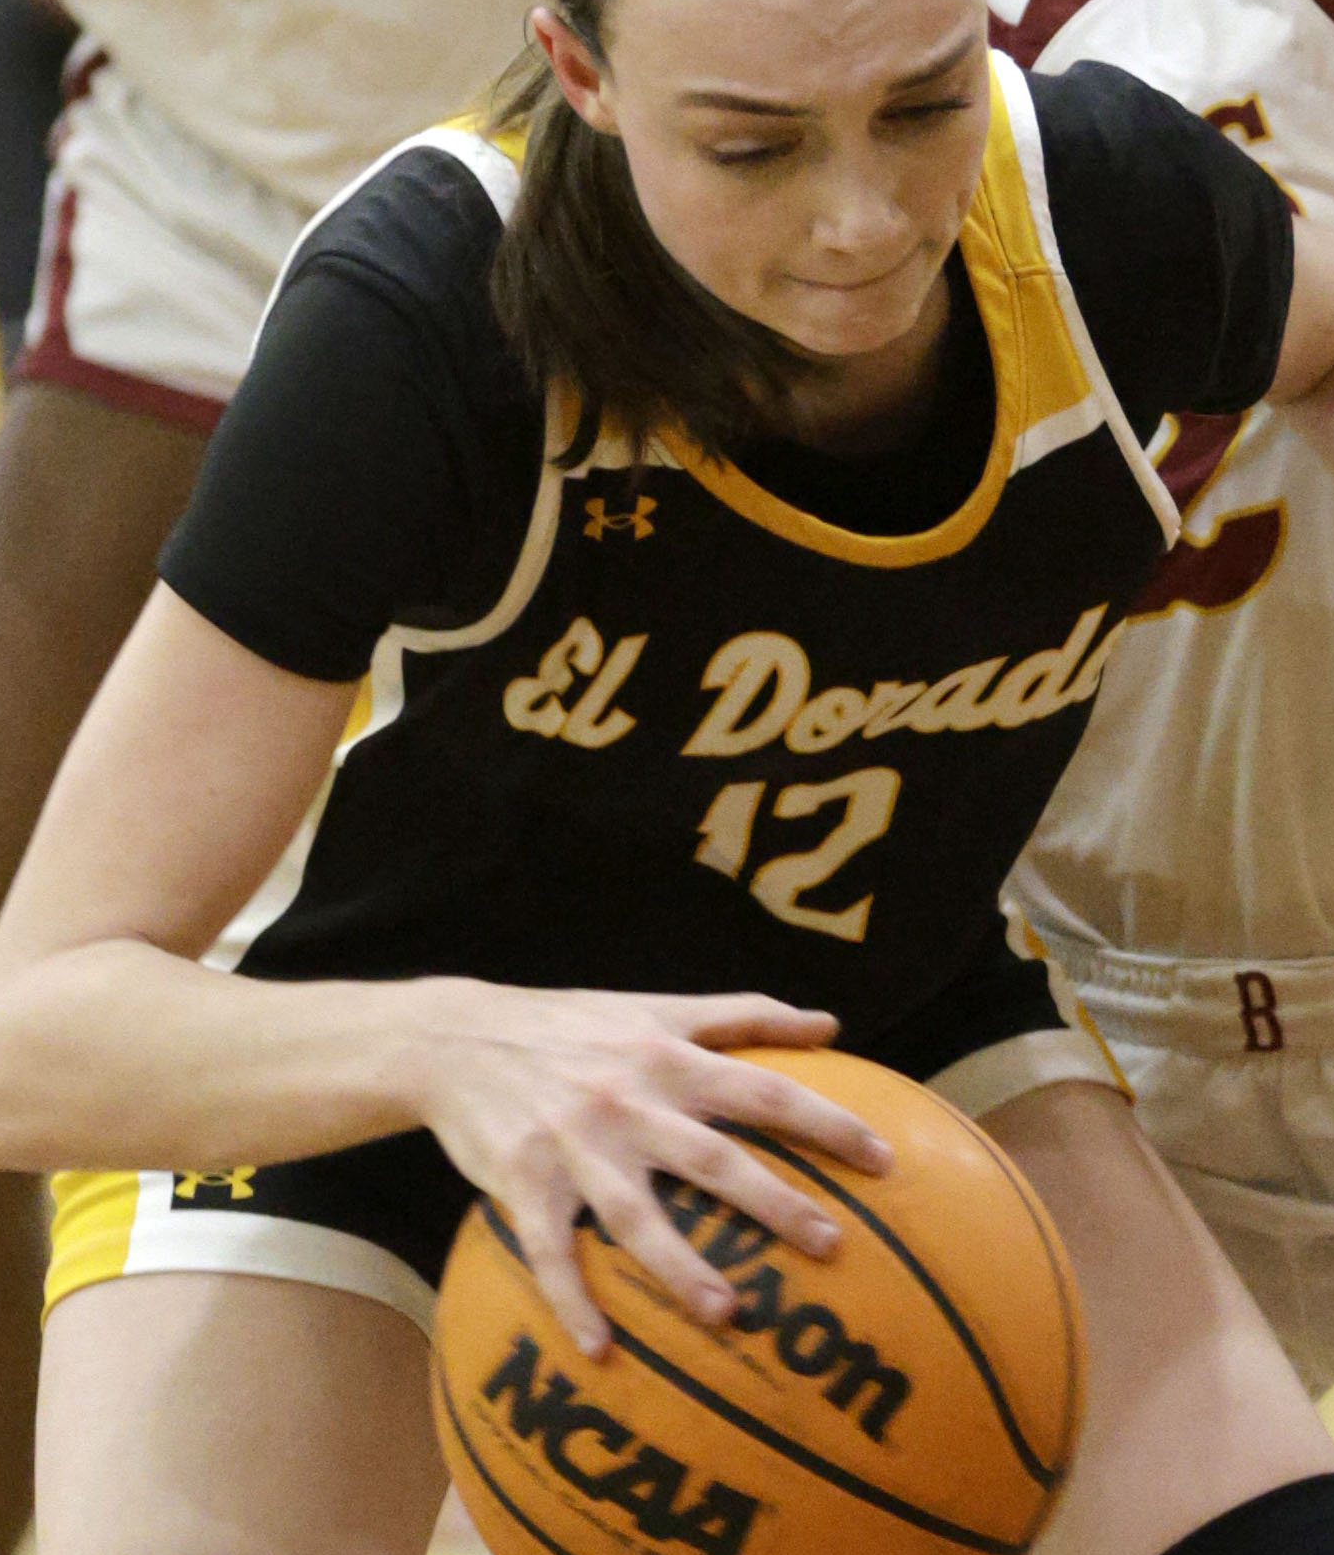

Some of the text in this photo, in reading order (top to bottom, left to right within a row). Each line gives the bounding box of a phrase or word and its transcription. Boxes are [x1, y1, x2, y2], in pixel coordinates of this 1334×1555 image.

[503, 616, 649, 750] El
[693, 765, 903, 945] 12
[1234, 970, 1284, 1052] B
